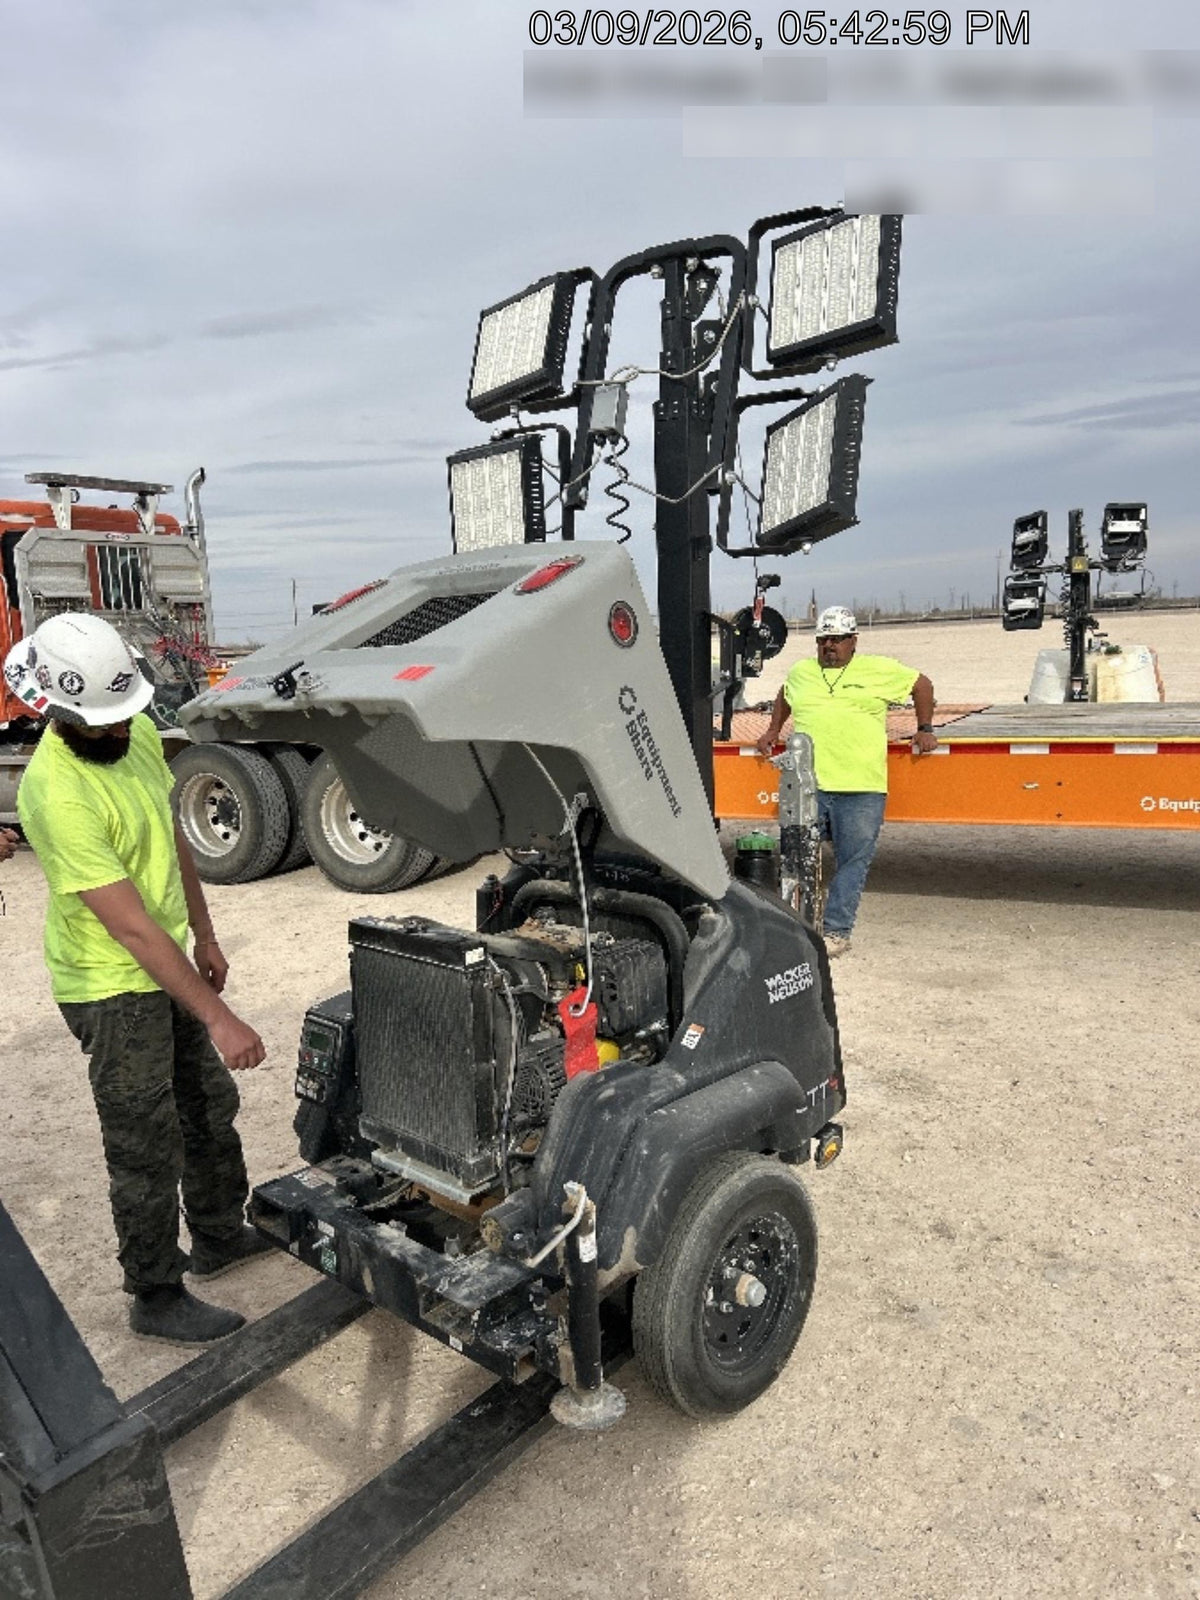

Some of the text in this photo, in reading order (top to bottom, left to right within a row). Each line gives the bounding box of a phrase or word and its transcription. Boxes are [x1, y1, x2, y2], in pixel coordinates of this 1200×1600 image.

[625, 719, 654, 781] Share
[636, 709, 682, 818] Equipment
[764, 962, 811, 990] WACKER
[767, 973, 814, 1004] NEUSON
